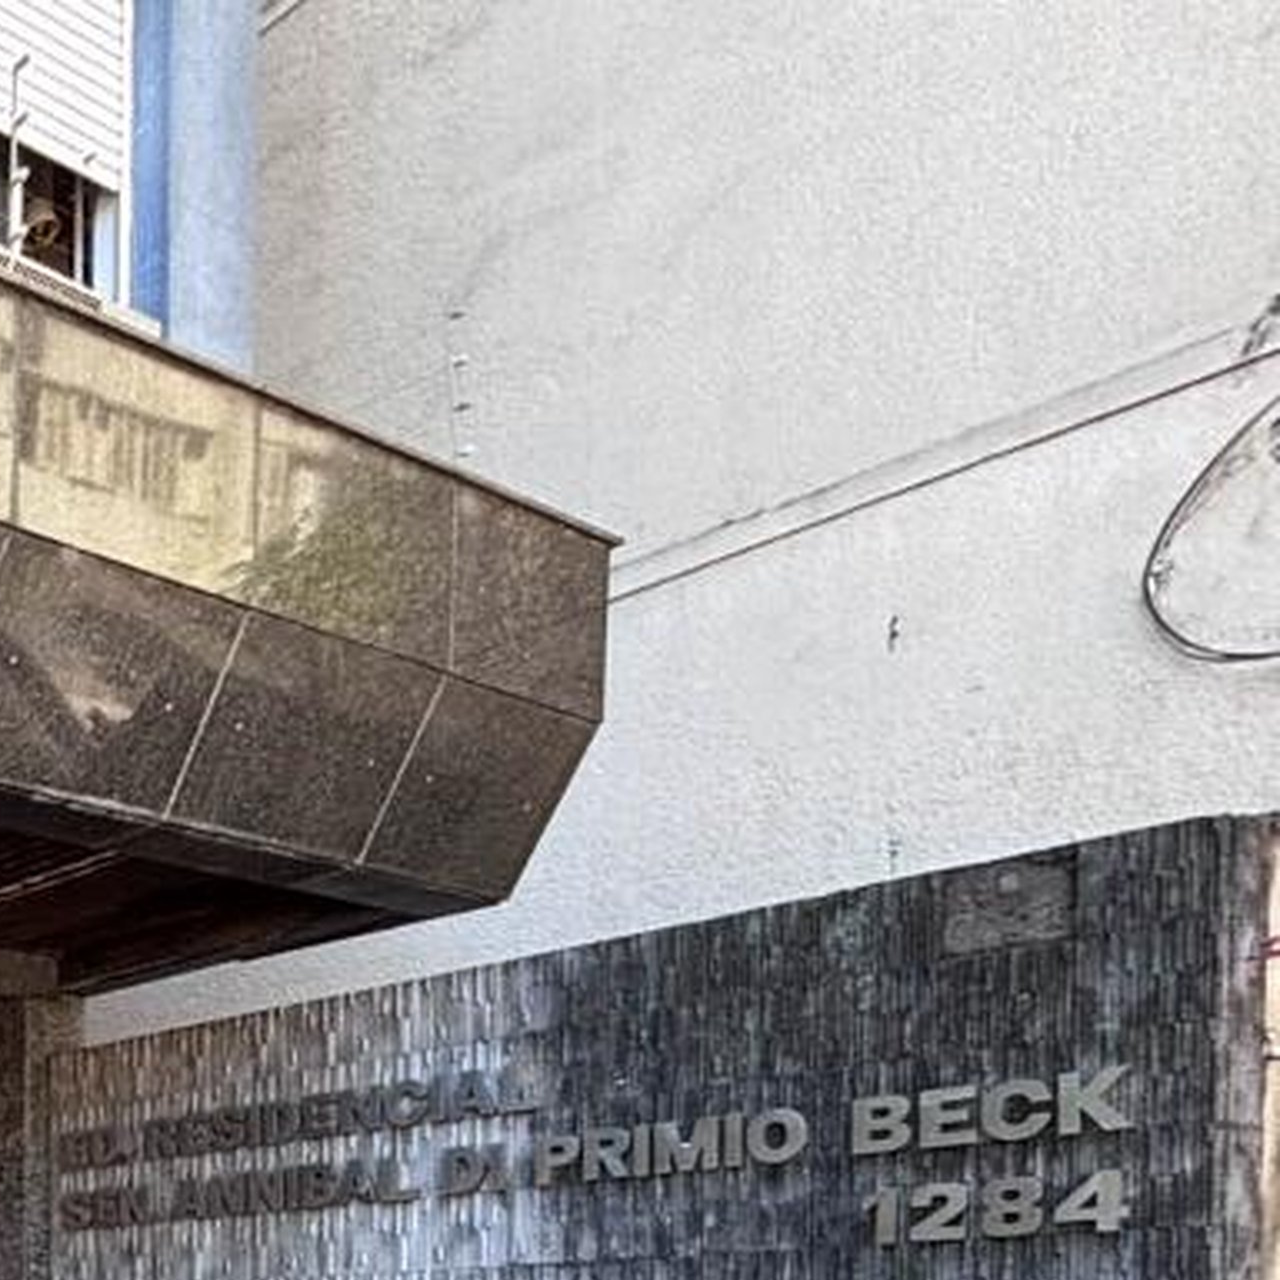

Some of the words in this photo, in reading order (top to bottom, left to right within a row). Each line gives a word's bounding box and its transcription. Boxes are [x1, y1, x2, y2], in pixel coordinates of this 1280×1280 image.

[170, 1158, 421, 1220] ANNIBAL
[536, 1107, 809, 1186] PRIMIO
[851, 1063, 1133, 1156] BECK
[864, 1168, 1132, 1247] 1284
